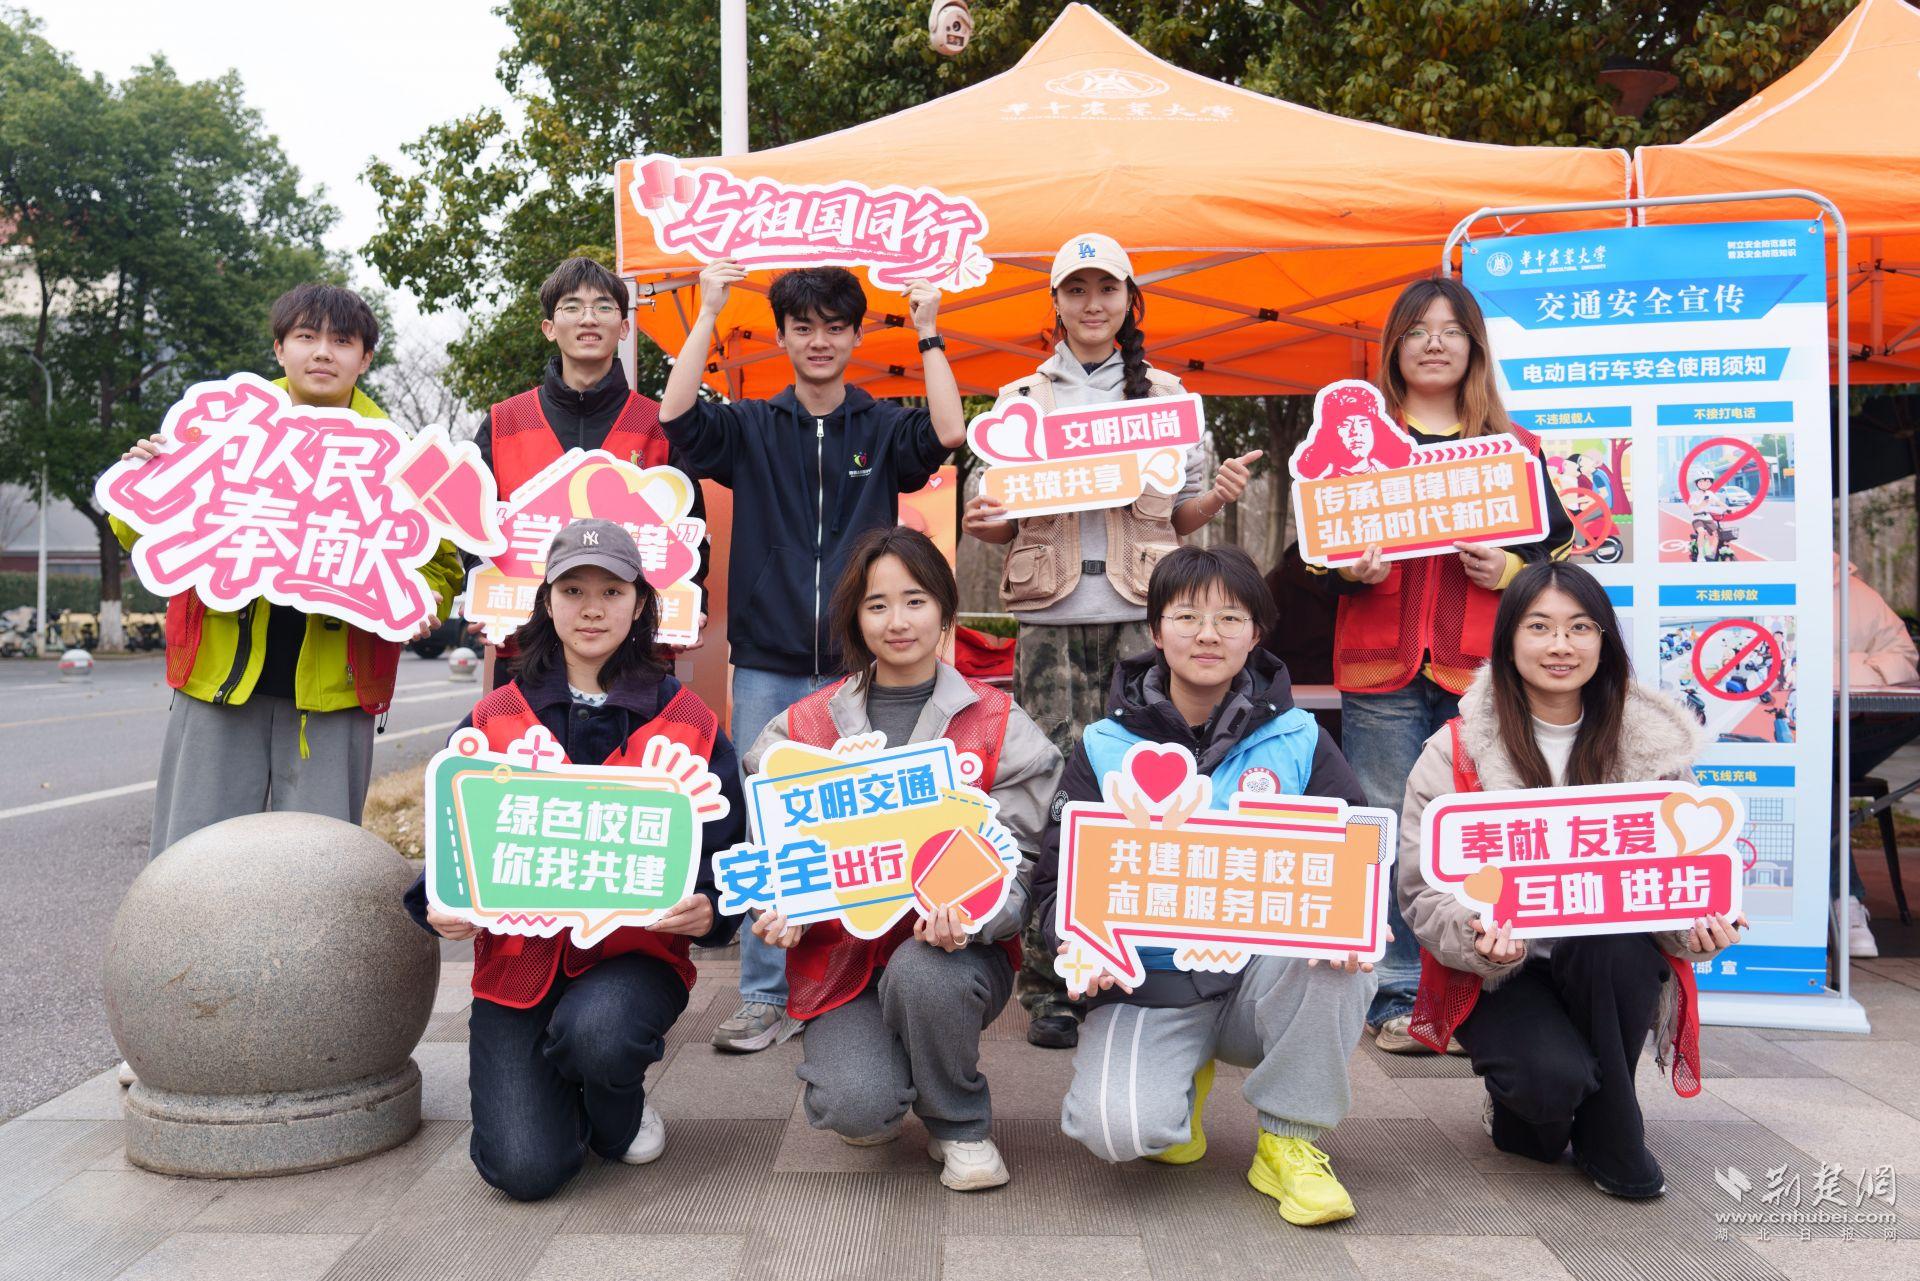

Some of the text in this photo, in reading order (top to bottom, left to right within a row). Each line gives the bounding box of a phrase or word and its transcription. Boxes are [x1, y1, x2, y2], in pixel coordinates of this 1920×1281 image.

[671, 181, 975, 277] 与祖国同行
[1078, 242, 1096, 258] LA
[1535, 283, 1745, 323] 交通安全宣传
[1522, 355, 1767, 384] 电动自行车安全使用须知
[1061, 409, 1182, 450] 文明风尚
[1535, 412, 1596, 426] 不违规载人
[1693, 406, 1757, 421] 不接打电话
[134, 396, 386, 525] 为人民
[1003, 463, 1124, 505] 共筑共享
[1313, 462, 1515, 516] 传承雷锋精神
[583, 530, 599, 546] NY
[1316, 494, 1520, 549] 弘扬时代新风
[156, 486, 417, 622] 奉献
[1695, 589, 1759, 602] 不违规停放
[780, 763, 939, 828] 文明交通
[1695, 769, 1758, 783] 不飞线充电
[495, 793, 672, 848] 绿色校园
[1460, 811, 1657, 864] 奉献 友爱
[491, 841, 667, 897] 你我共建
[719, 840, 904, 908] 安全出行
[1108, 839, 1335, 888] 共建和美校园
[1106, 880, 1333, 929] 志愿服务同行
[1513, 865, 1711, 918] 互助 进步
[1720, 960, 1738, 976] 宣
